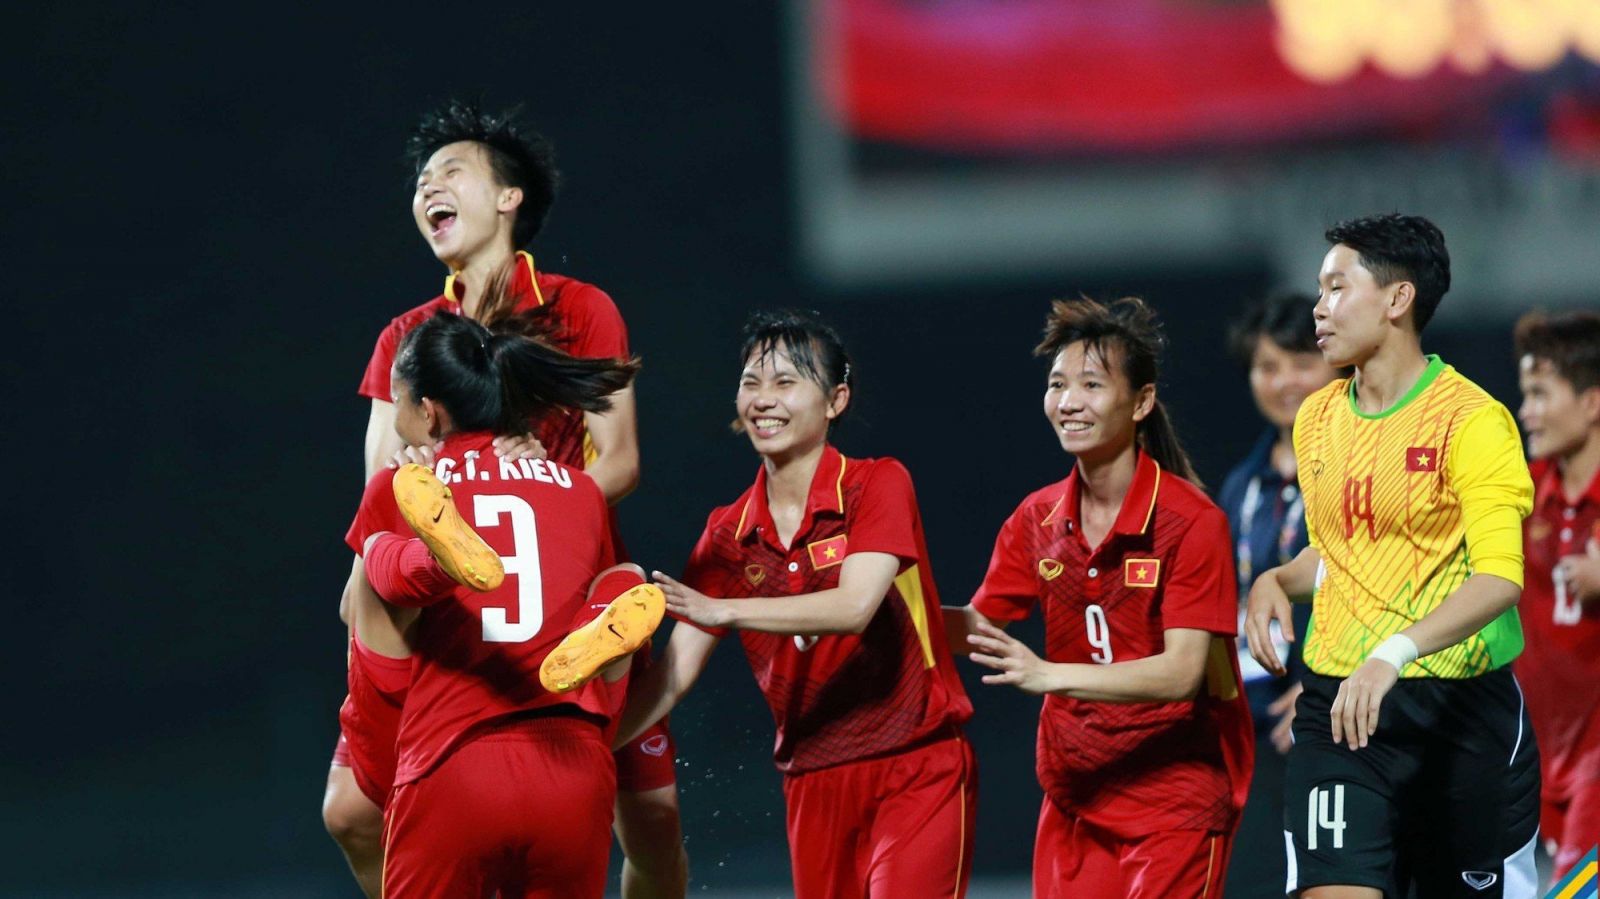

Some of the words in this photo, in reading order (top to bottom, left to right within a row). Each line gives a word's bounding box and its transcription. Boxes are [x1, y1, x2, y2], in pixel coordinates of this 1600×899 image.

[1344, 475, 1375, 542] 14
[473, 494, 544, 643] 3
[1085, 604, 1113, 665] 9
[1308, 784, 1347, 850] 14
